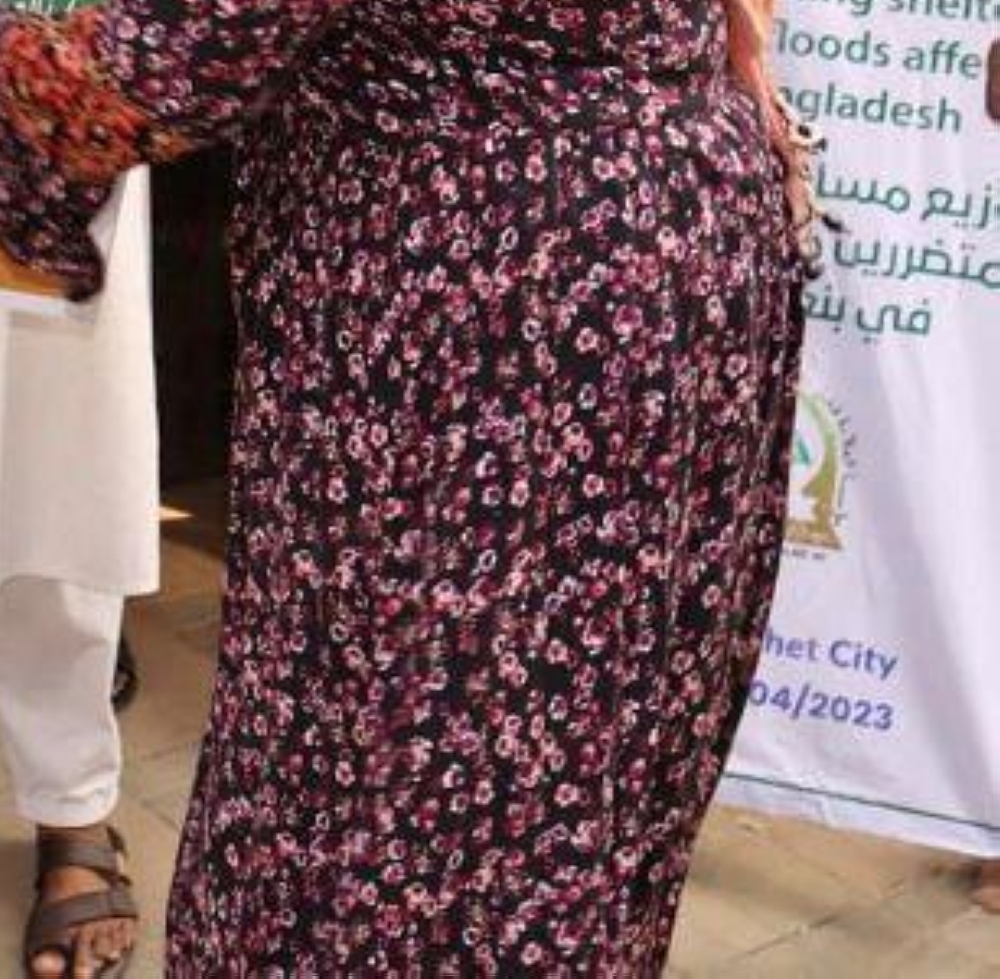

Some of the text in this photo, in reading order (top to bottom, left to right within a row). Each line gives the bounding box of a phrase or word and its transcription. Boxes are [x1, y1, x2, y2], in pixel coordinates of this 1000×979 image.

[774, 18, 982, 80] loods affe
[816, 161, 911, 214] مسا
[833, 238, 1000, 290] متضررين
[856, 298, 932, 344] في
[764, 628, 898, 678] het City
[749, 682, 895, 731] 04/2023
